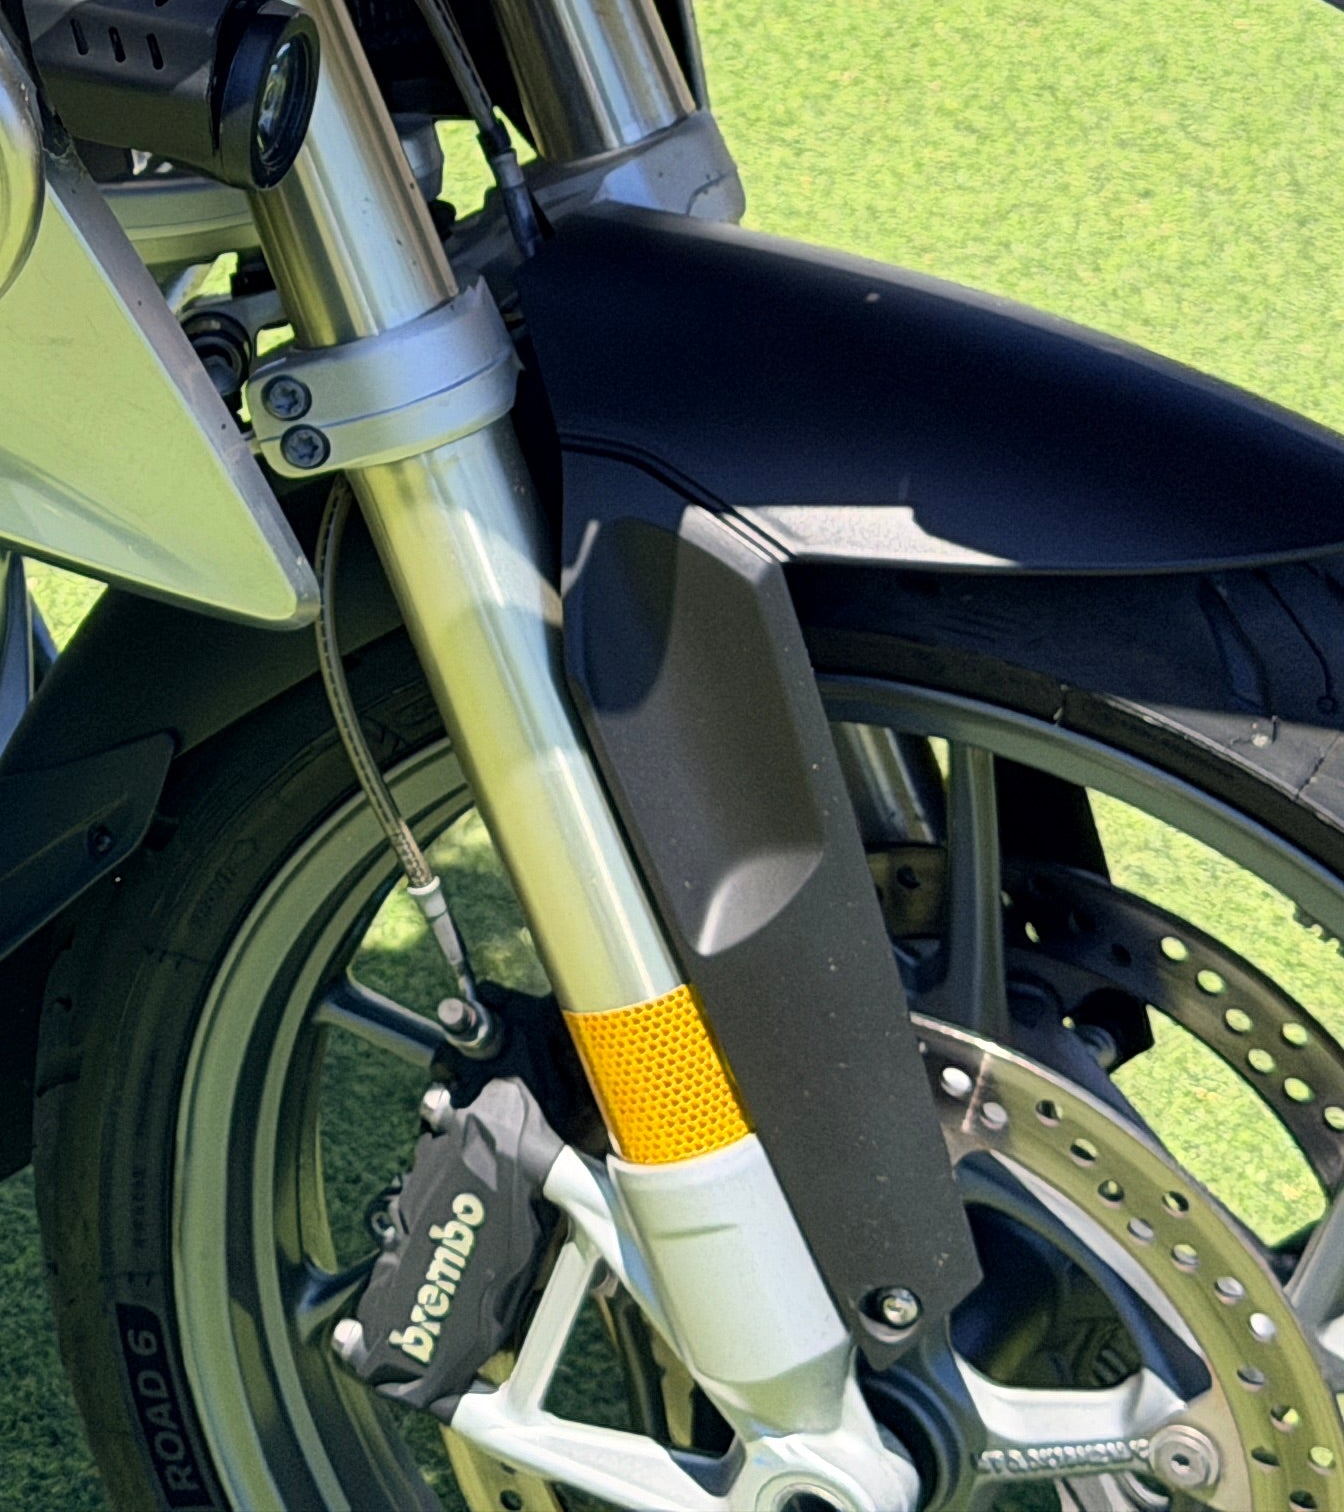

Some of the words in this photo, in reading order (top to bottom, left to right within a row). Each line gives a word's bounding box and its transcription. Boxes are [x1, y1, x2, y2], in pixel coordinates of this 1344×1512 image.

[389, 1192, 486, 1366] brembo
[127, 1328, 159, 1358] 6
[137, 1369, 202, 1492] ROAD
